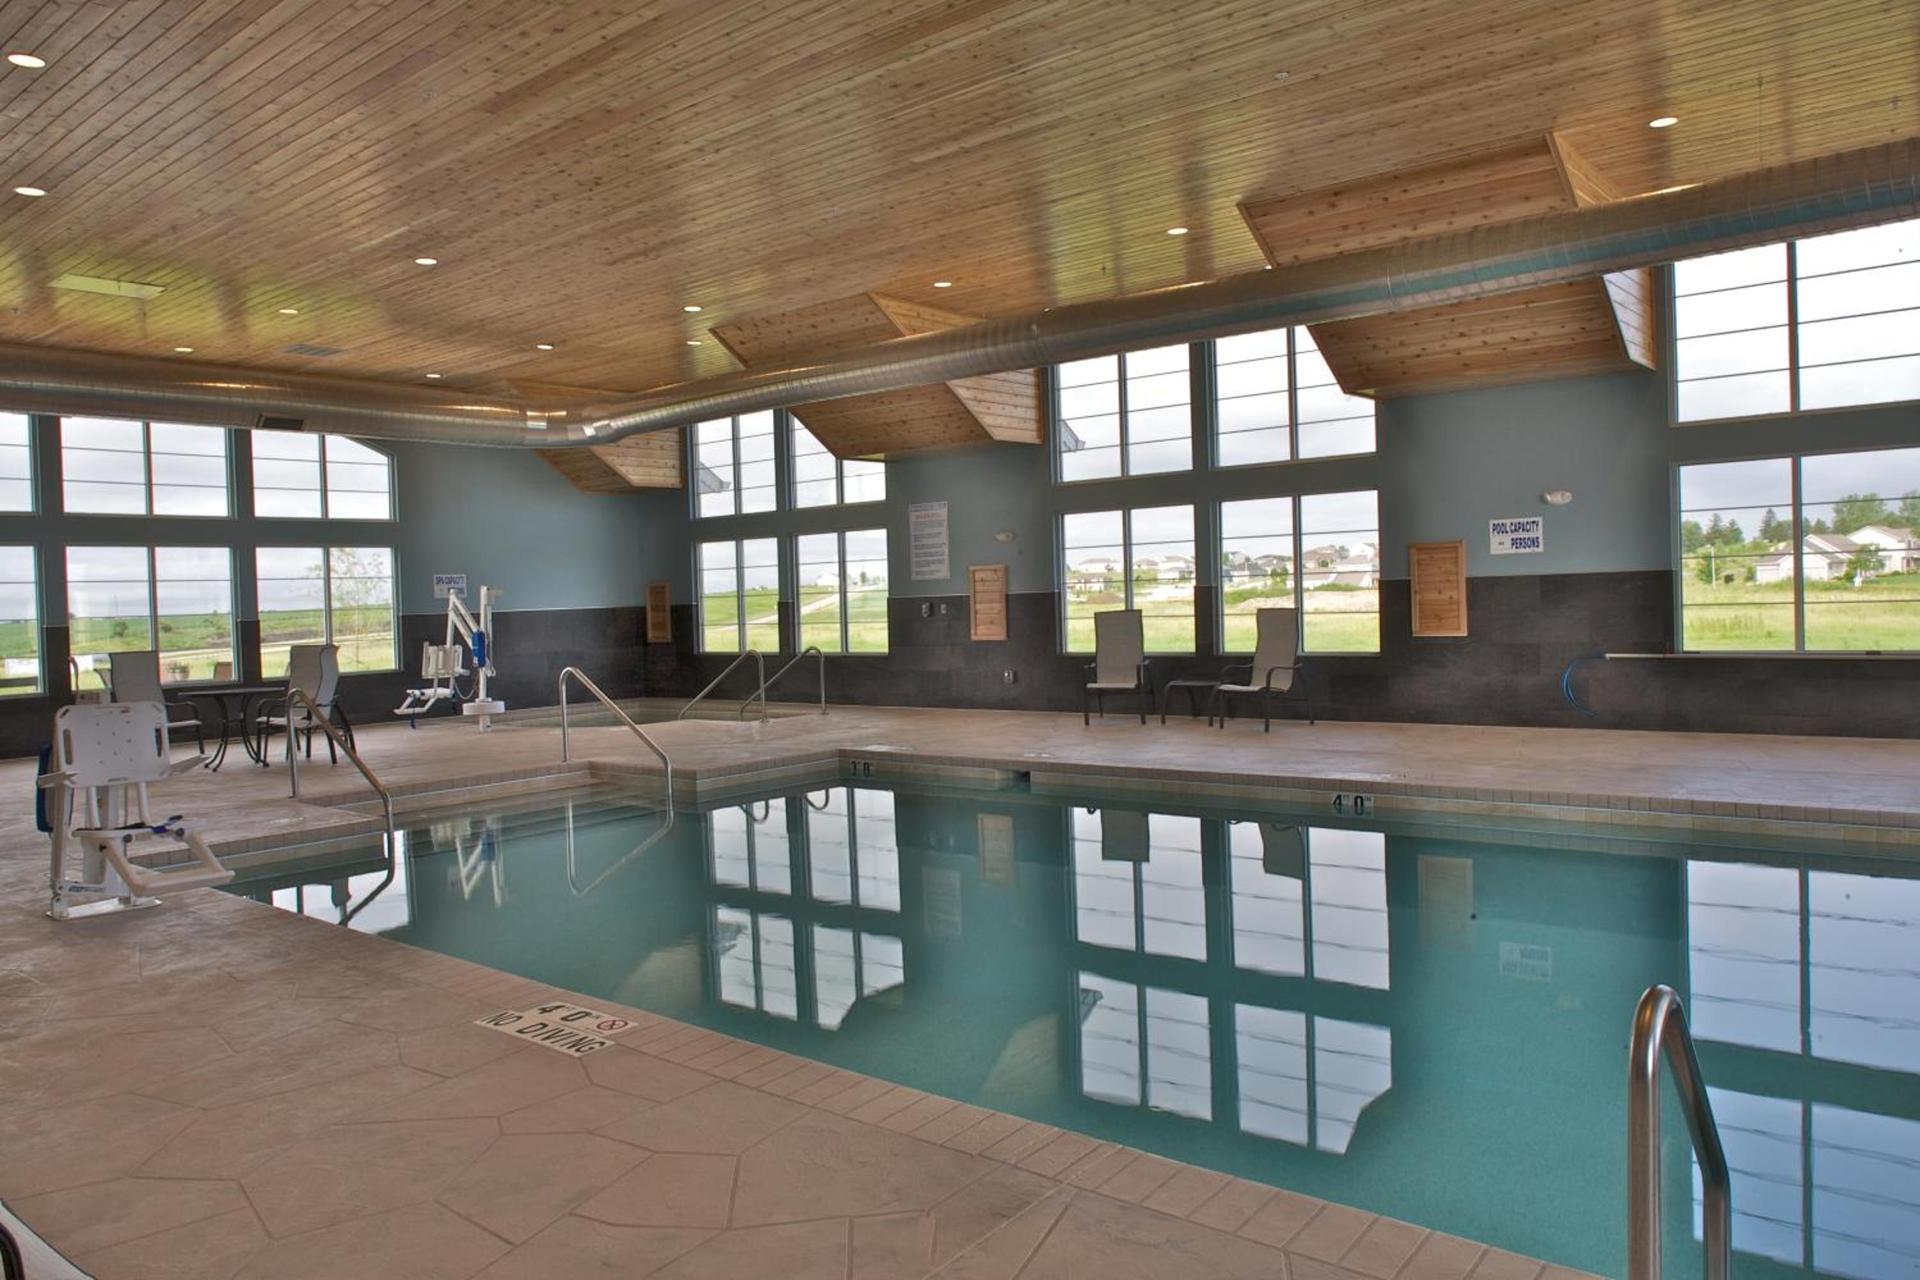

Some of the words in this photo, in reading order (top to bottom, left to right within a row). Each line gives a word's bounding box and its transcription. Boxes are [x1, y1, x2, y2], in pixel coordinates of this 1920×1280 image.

[1492, 522, 1509, 534] POOL
[1510, 520, 1540, 532] CAPACITY
[1511, 537, 1540, 549] PERSONS
[481, 1011, 523, 1027] NO
[516, 1022, 606, 1053] DIVING
